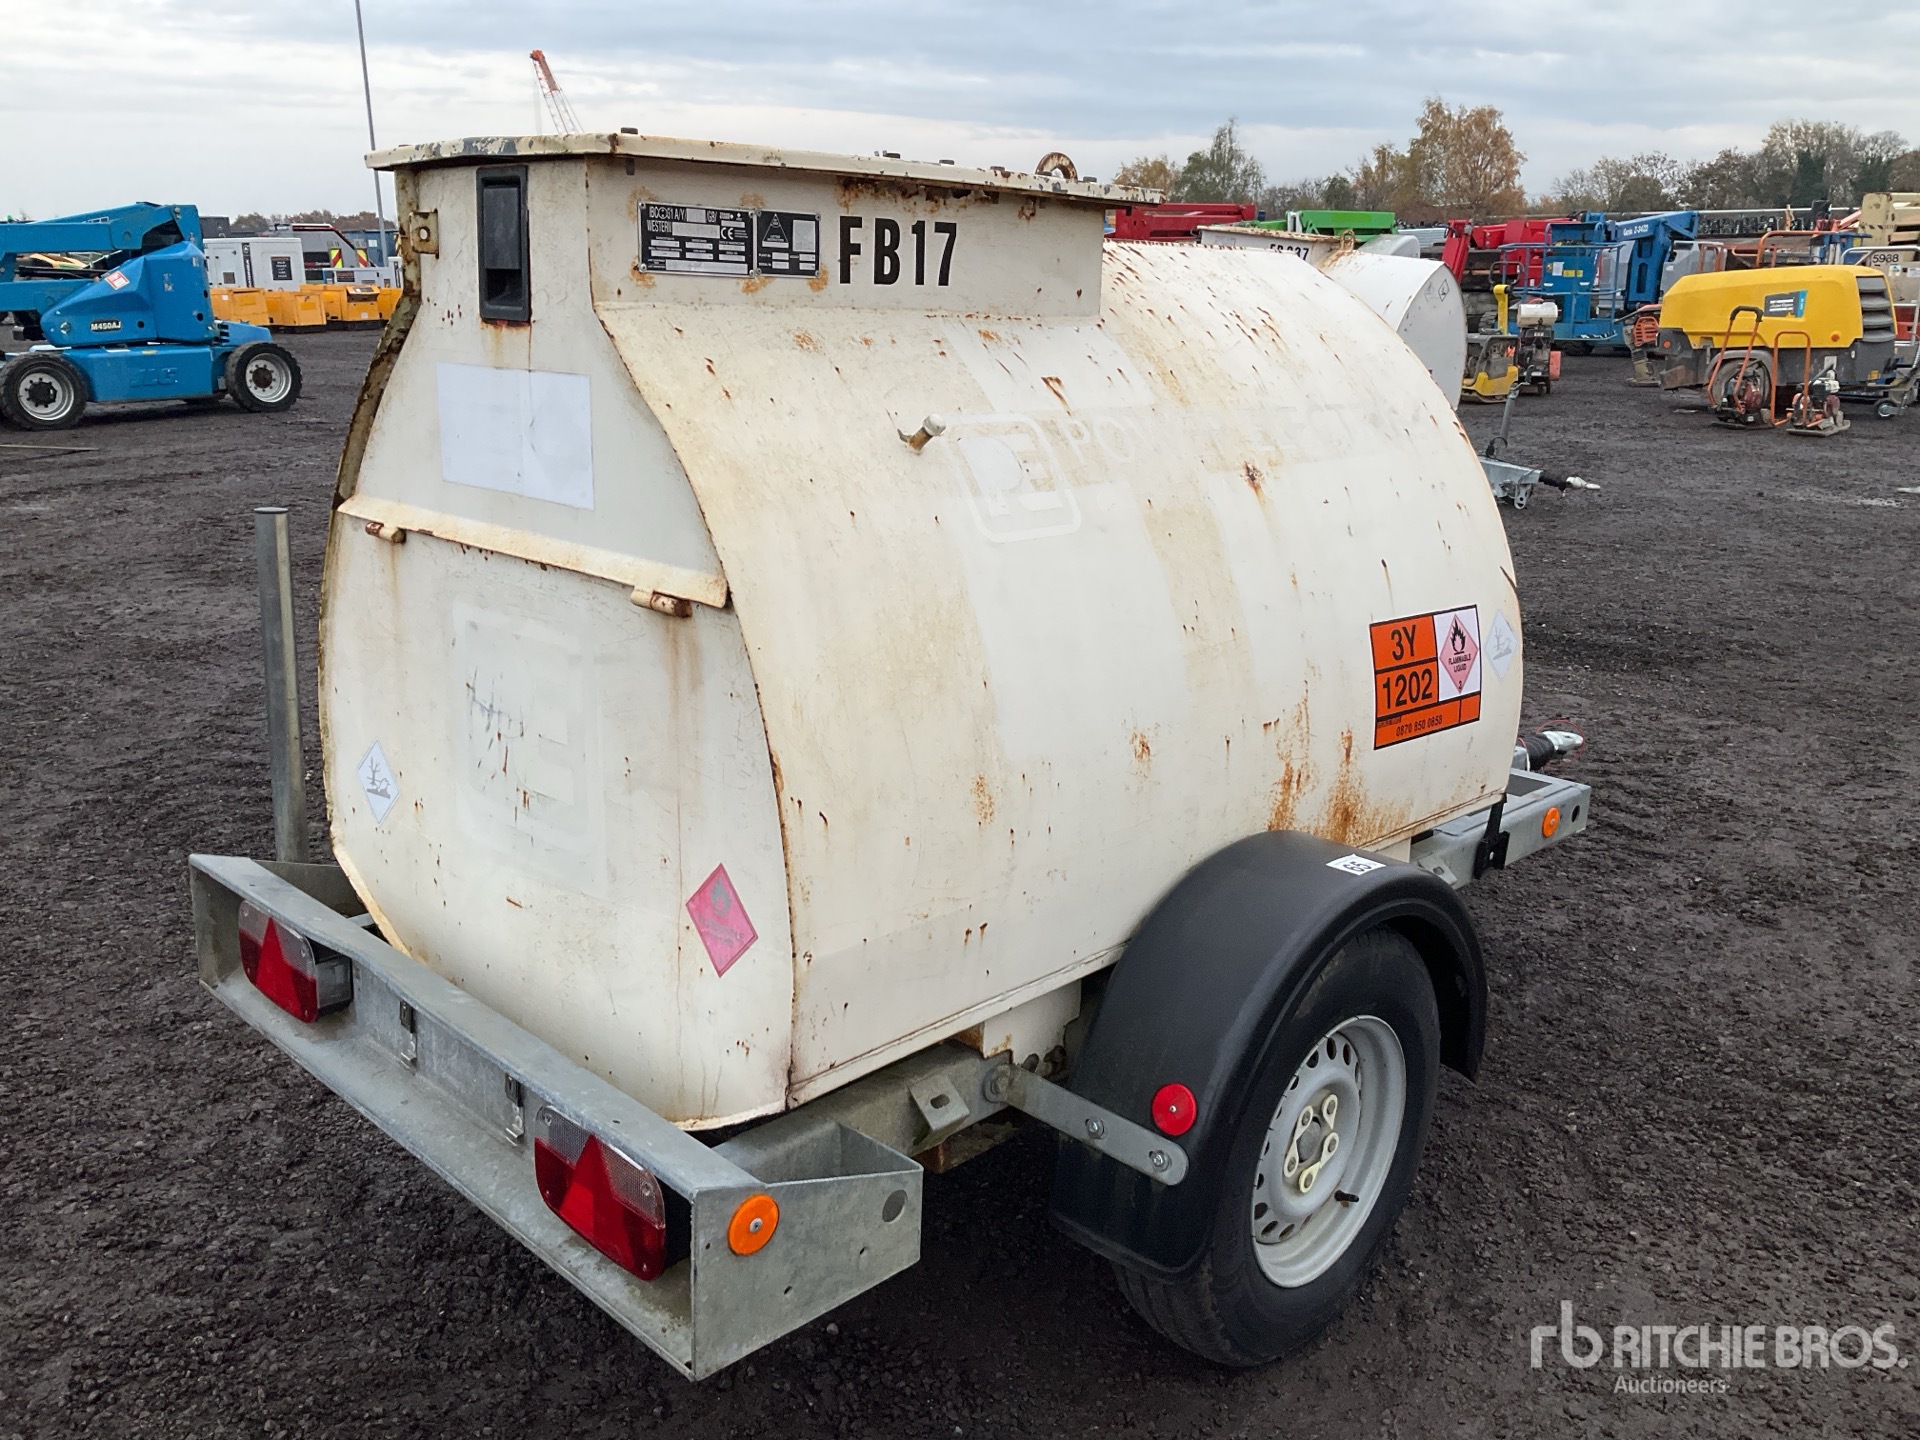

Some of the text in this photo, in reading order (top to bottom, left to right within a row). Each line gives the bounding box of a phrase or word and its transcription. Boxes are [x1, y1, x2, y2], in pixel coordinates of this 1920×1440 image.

[839, 215, 957, 286] FB17
[1390, 624, 1416, 661] 3Y
[1448, 653, 1471, 666] FLAMMABLE
[1453, 663, 1467, 673] LIQUID
[1382, 668, 1433, 709] 1202
[1396, 723, 1412, 736] 0870
[1413, 719, 1426, 731] 850
